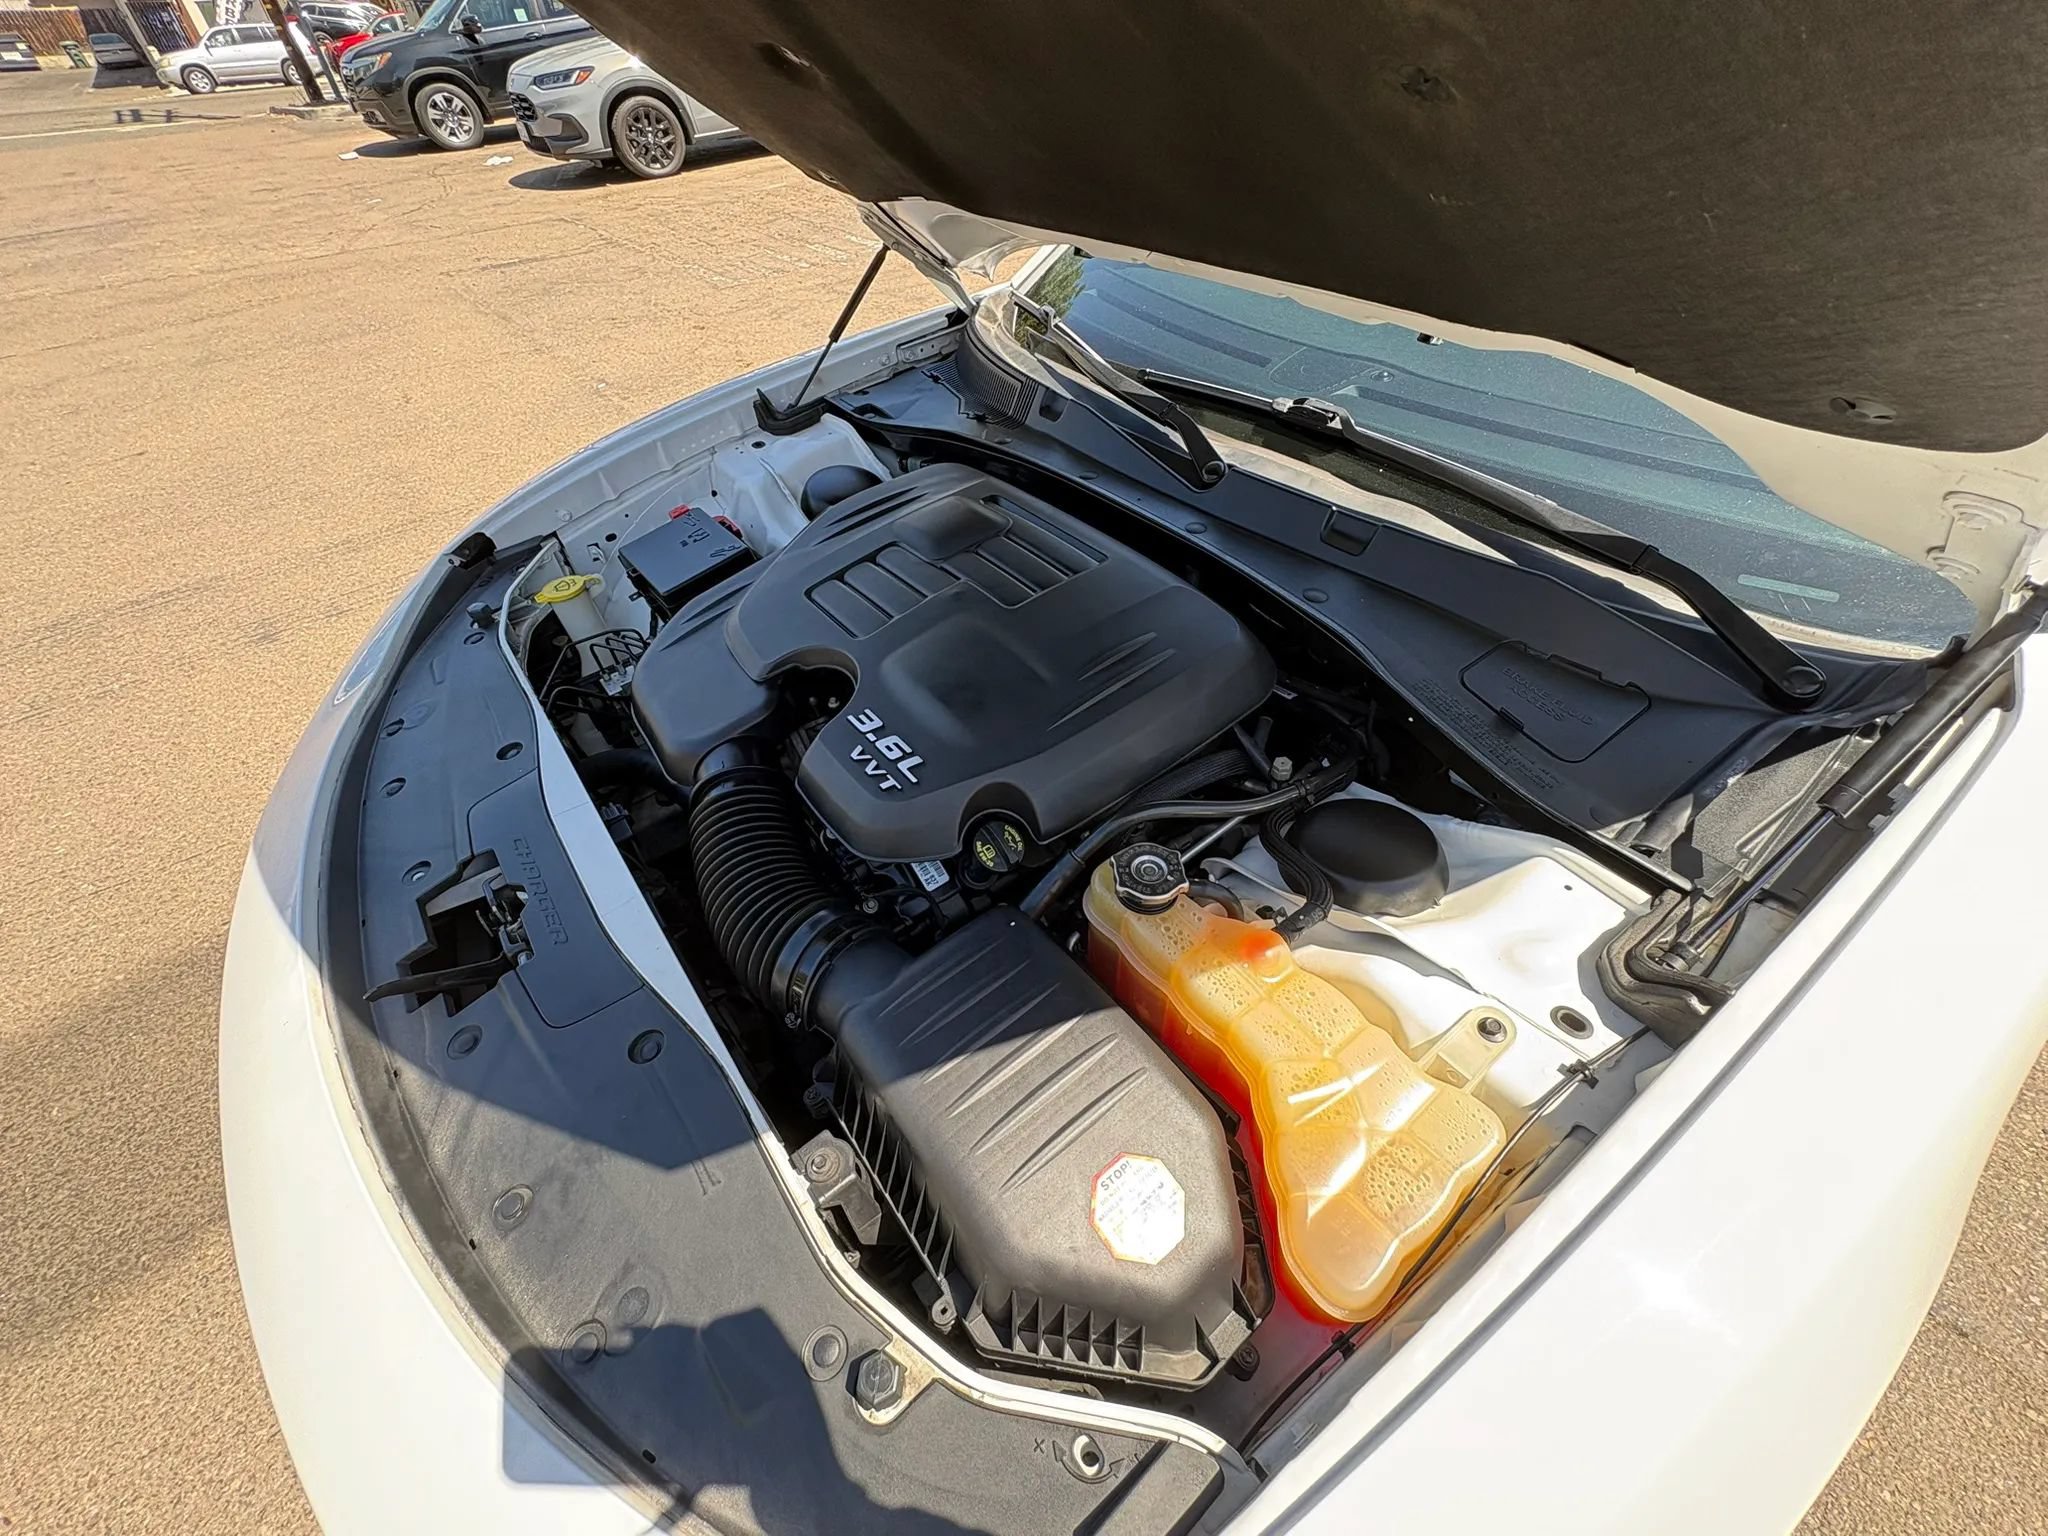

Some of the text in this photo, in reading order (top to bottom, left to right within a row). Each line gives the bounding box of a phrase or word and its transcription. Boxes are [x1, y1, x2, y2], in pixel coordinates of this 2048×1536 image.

[846, 707, 925, 784] 3.6L
[849, 744, 903, 792] VVT
[513, 837, 569, 946] CHARGER
[1100, 1160, 1131, 1191] STOP!
